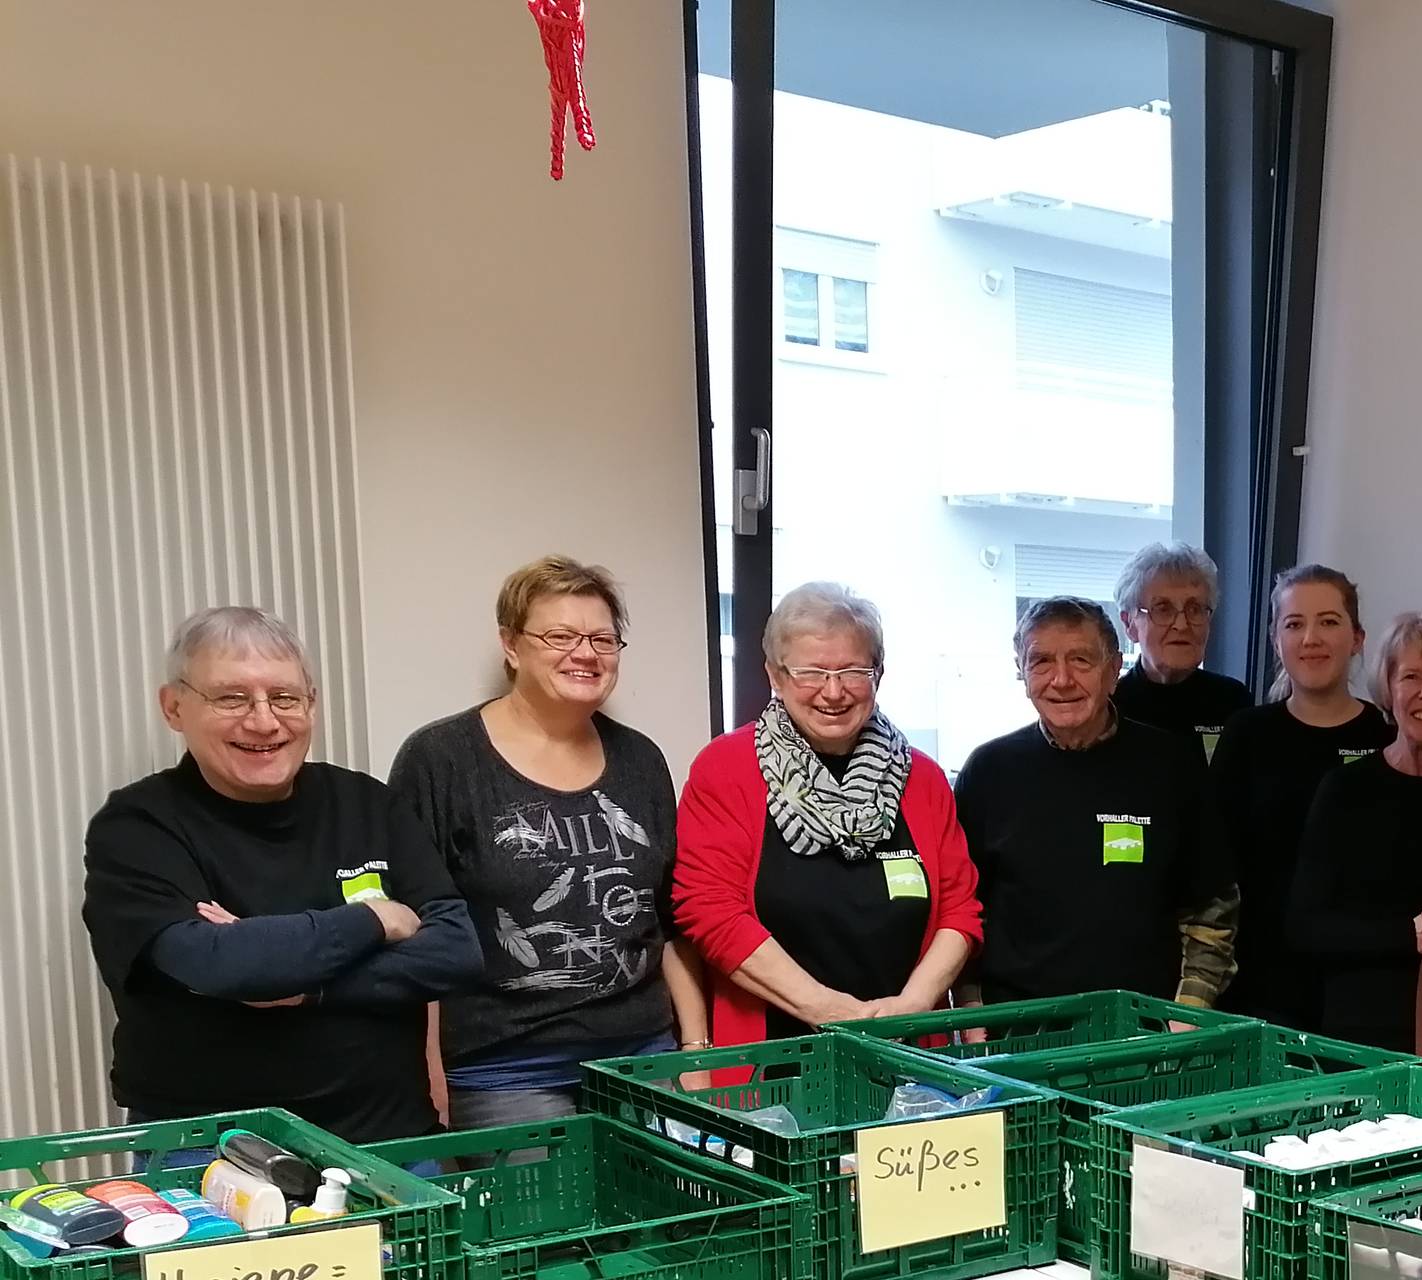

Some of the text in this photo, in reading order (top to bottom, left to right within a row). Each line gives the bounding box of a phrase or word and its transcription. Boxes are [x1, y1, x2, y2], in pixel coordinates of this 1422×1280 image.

[1096, 814, 1151, 825] VORHALLER PALETTE
[874, 1139, 980, 1192] Süßes
